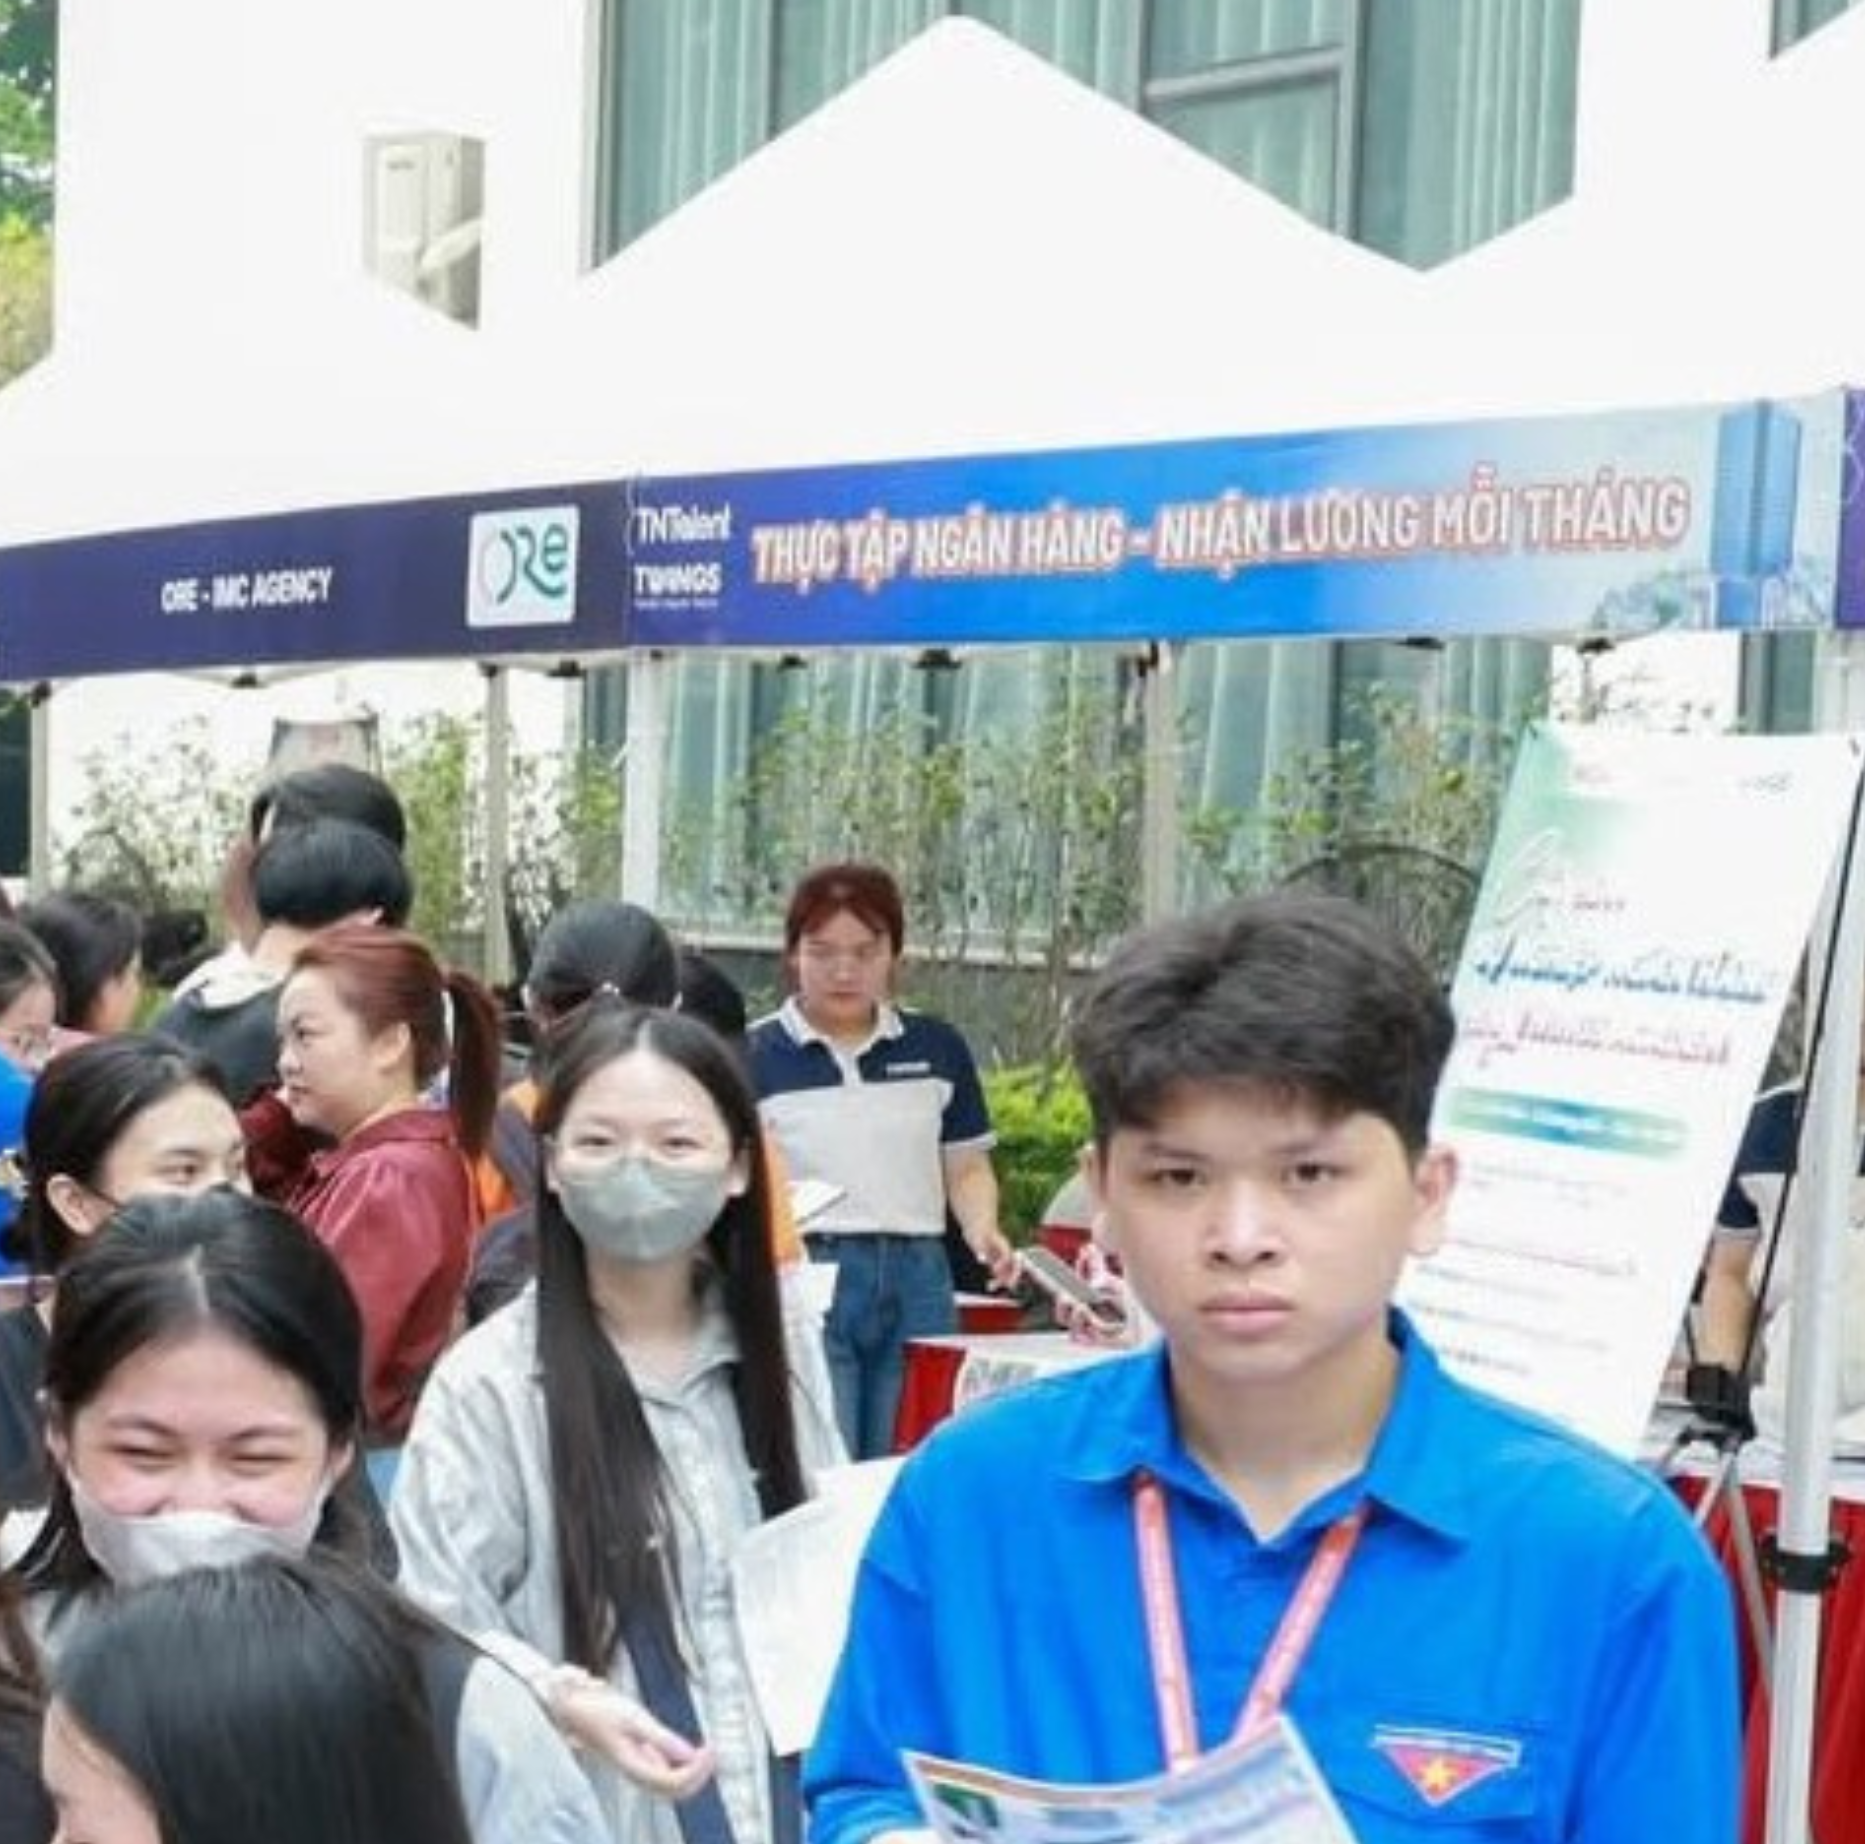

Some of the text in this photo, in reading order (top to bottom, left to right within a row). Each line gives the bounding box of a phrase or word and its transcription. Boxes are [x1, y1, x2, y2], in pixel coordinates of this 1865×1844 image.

[750, 517, 840, 595] THỰC
[843, 507, 906, 594] TẬP
[913, 502, 1016, 578] NGÂN
[1020, 498, 1124, 575] HÀNG
[1156, 487, 1270, 581] NHẬN
[1277, 486, 1421, 557] LƯƠNG
[1431, 459, 1509, 553] MỖI
[1525, 466, 1691, 549] THÁNG
[252, 566, 332, 608] AGENCY
